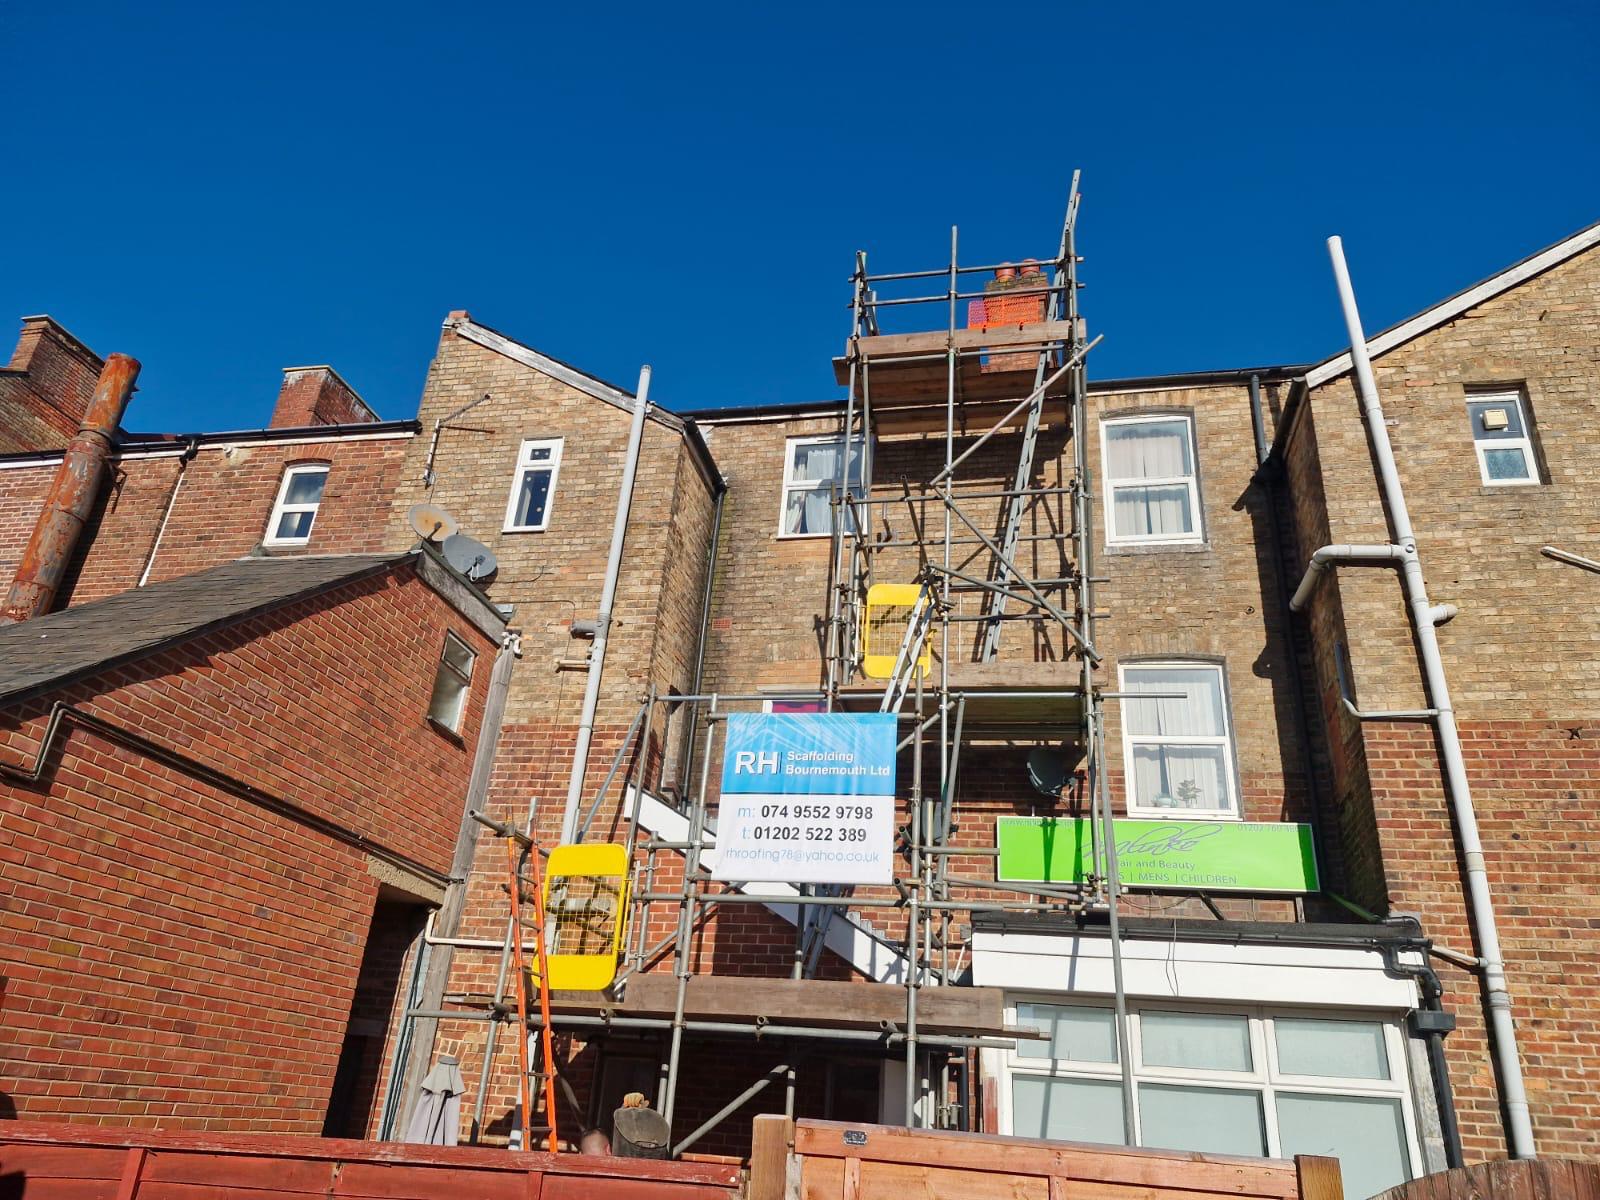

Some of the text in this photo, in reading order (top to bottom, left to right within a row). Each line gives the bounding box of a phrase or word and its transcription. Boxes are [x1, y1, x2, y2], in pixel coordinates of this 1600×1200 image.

[734, 751, 779, 775] RH
[787, 751, 854, 762] Scaffolding
[785, 765, 890, 776] Bournemouth Ltd
[737, 805, 873, 820] m: 074 9552 9798
[754, 826, 800, 841] 01202
[805, 827, 833, 842] 522
[838, 828, 867, 842] 389
[726, 847, 880, 864] rhroofing78@yahoo.co.uk
[1136, 858, 1156, 868] and
[1159, 861, 1196, 870] Beauty
[1138, 873, 1237, 885] MENS CHILDREN
